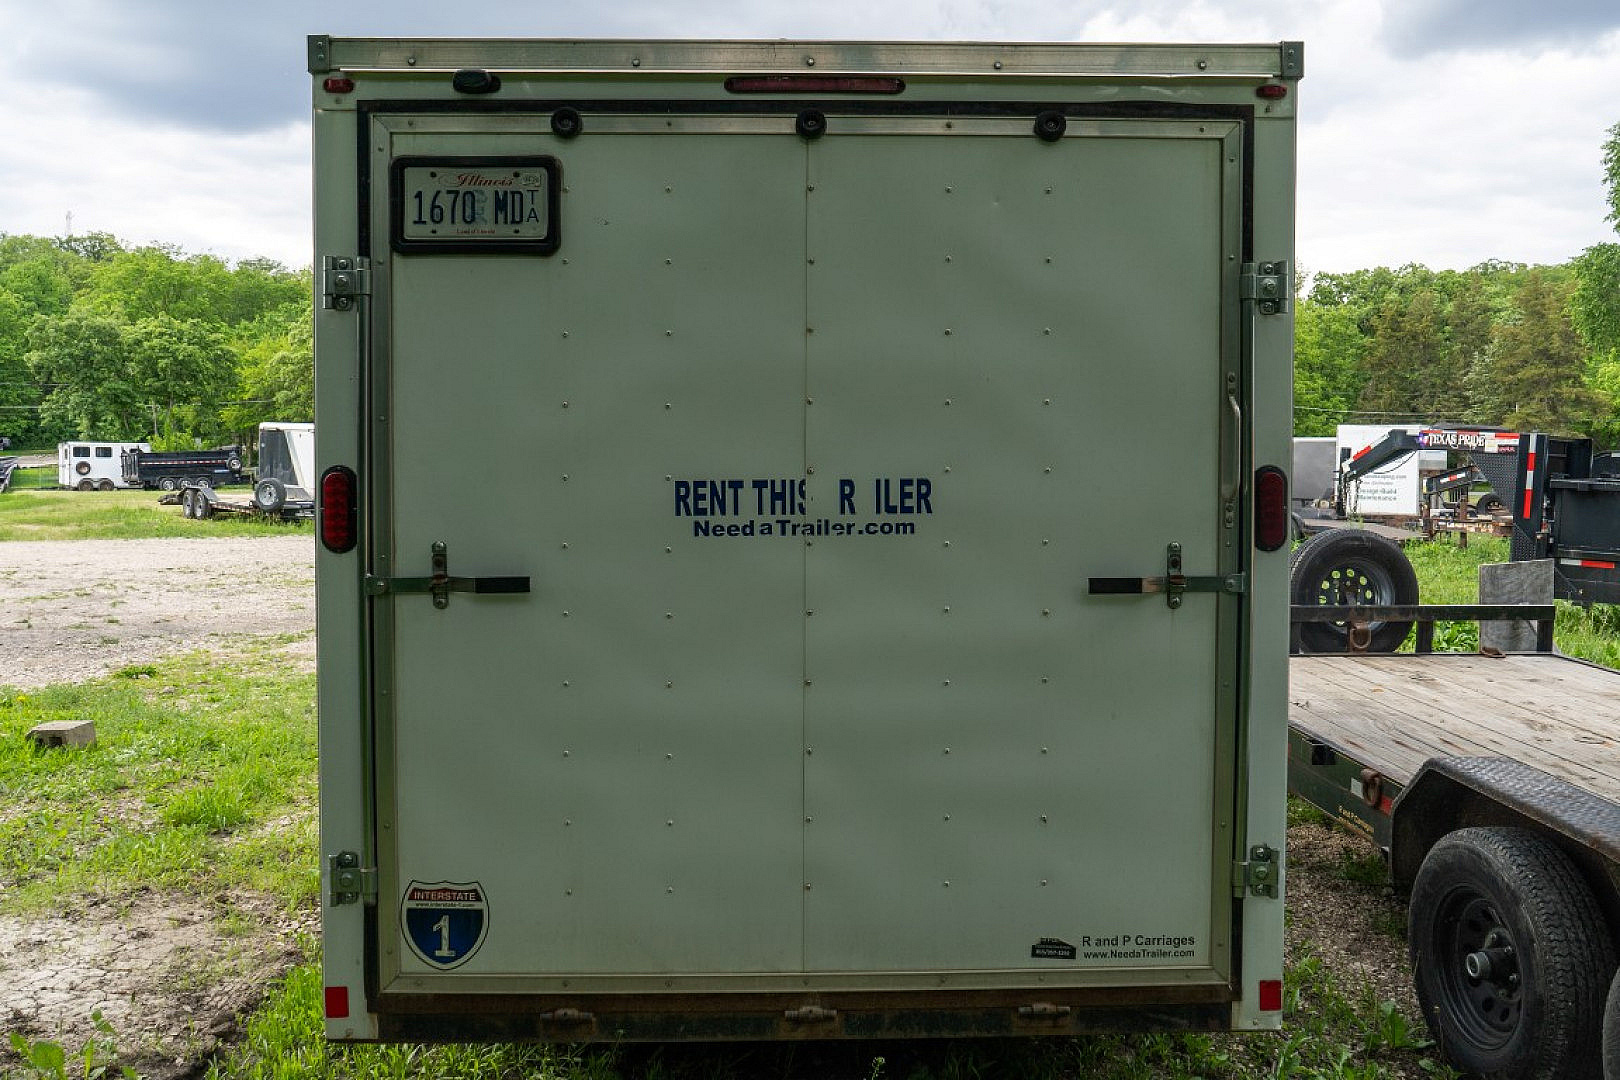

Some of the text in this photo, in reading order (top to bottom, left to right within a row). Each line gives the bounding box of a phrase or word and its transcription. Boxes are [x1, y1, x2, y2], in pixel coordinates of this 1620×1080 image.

[457, 173, 514, 187] Illinois
[413, 190, 476, 224] 1670
[494, 190, 524, 224] MD
[1428, 433, 1458, 449] TEXAS
[1458, 434, 1486, 449] PRIDE
[675, 480, 744, 516] RENT
[414, 891, 476, 901] INTERSTATE
[432, 915, 456, 957] 1
[1082, 934, 1195, 949] R and P Carriages
